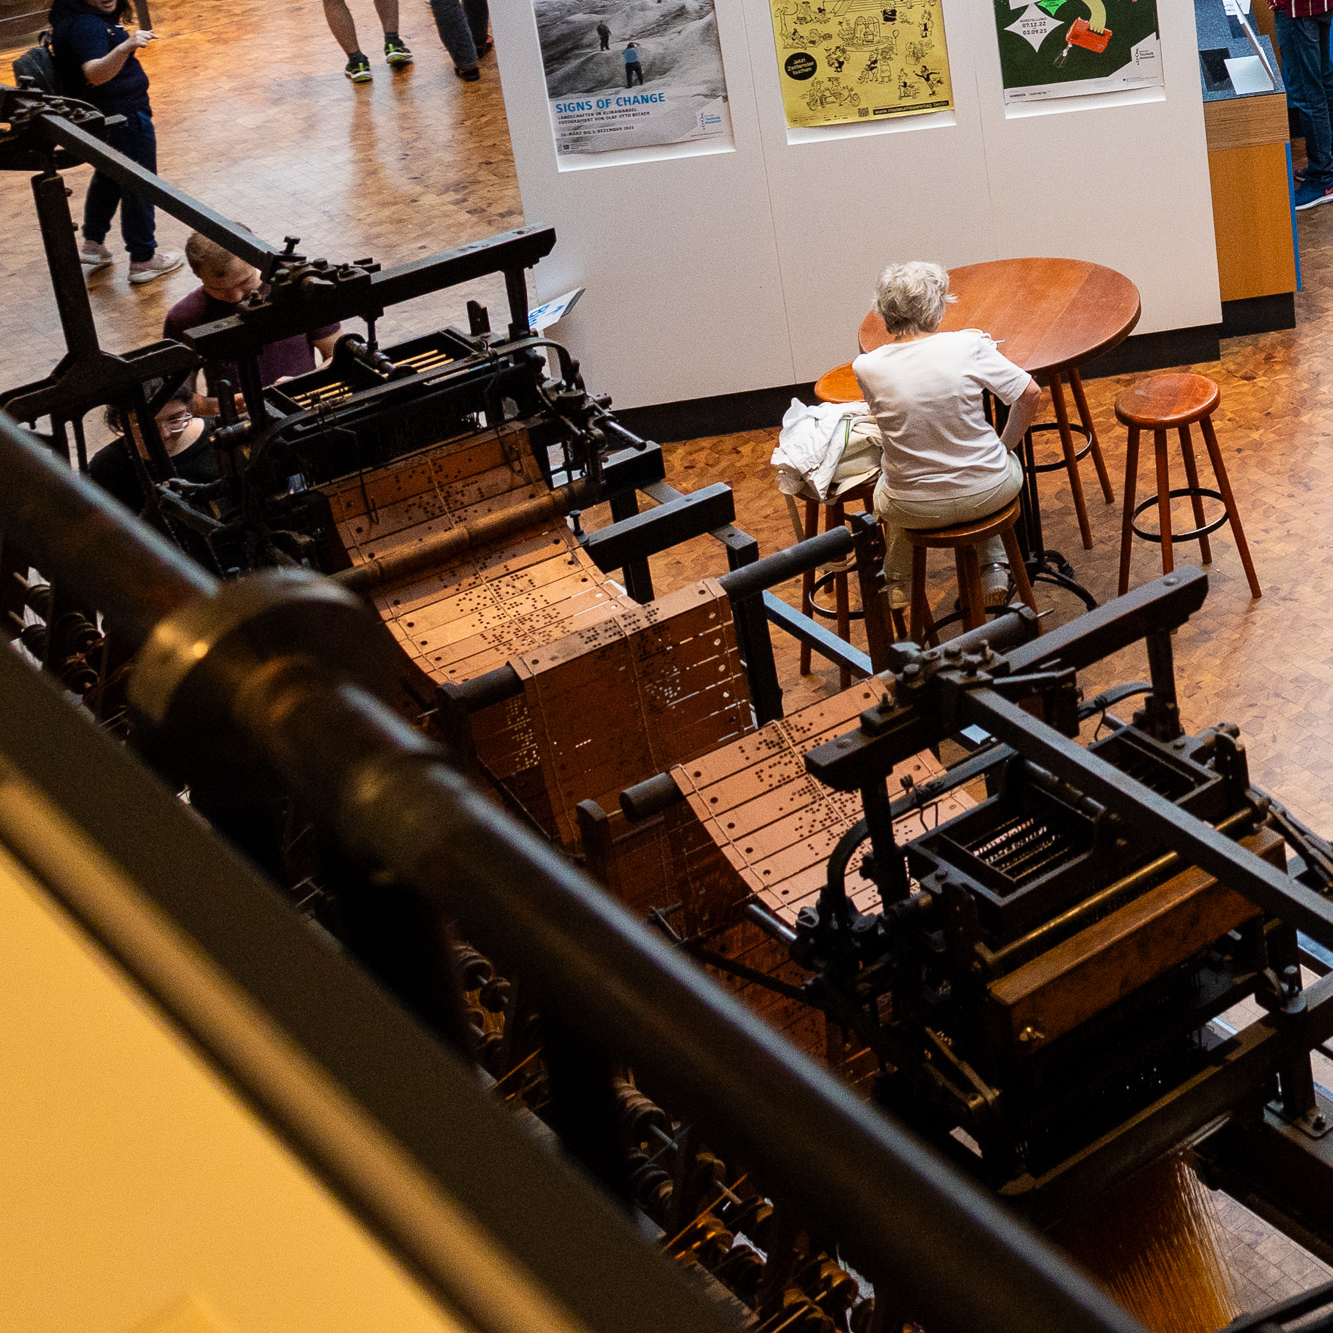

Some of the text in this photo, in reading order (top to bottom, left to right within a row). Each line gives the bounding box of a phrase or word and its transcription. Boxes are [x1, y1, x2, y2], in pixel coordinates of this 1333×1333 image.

[556, 93, 666, 113] SIGNS OF CHANGE
[558, 112, 594, 120] LANDSCHAFTEN
